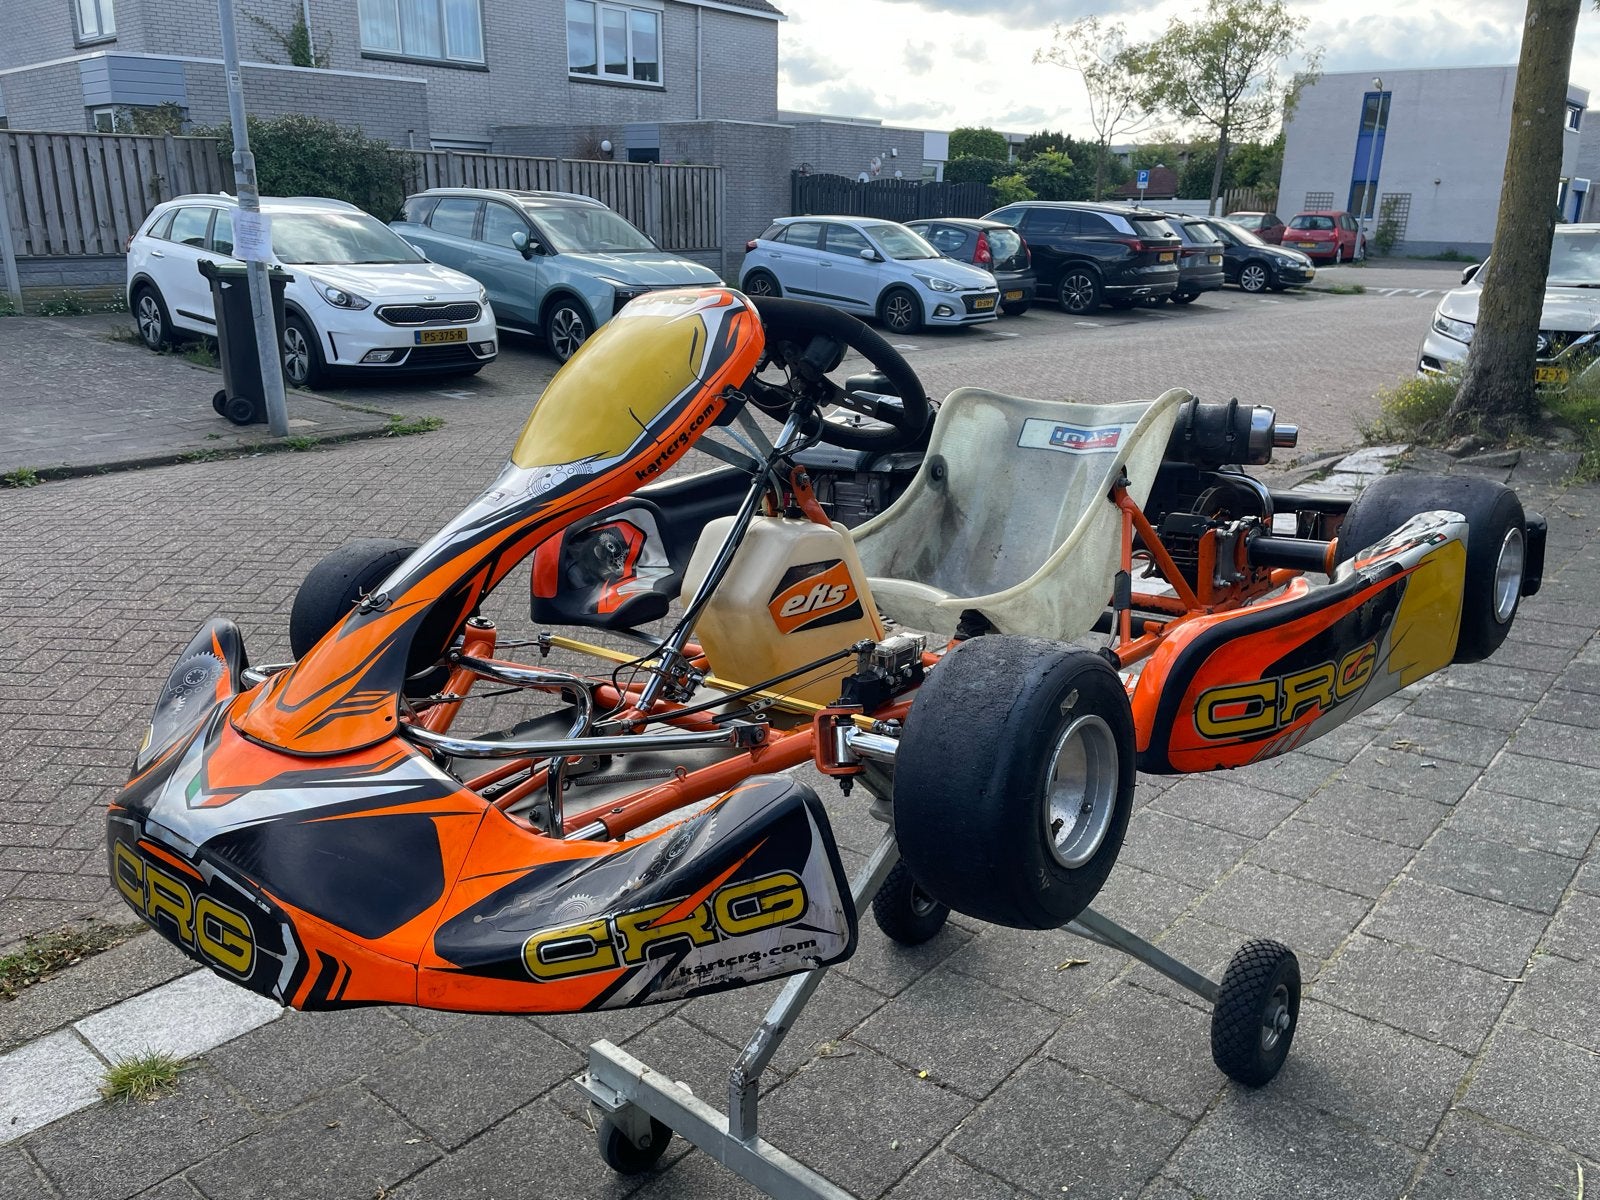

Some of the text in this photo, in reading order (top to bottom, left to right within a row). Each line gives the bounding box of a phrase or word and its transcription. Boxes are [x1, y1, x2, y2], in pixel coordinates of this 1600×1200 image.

[1139, 171, 1147, 181] P
[424, 331, 463, 342] PS-375-R
[1535, 368, 1563, 381] 12-X
[635, 403, 715, 481] kartcrg.com
[1194, 641, 1377, 738] CRG
[113, 838, 256, 980] CRG
[522, 871, 807, 981] CRG
[679, 939, 817, 978] kartcrg.com
